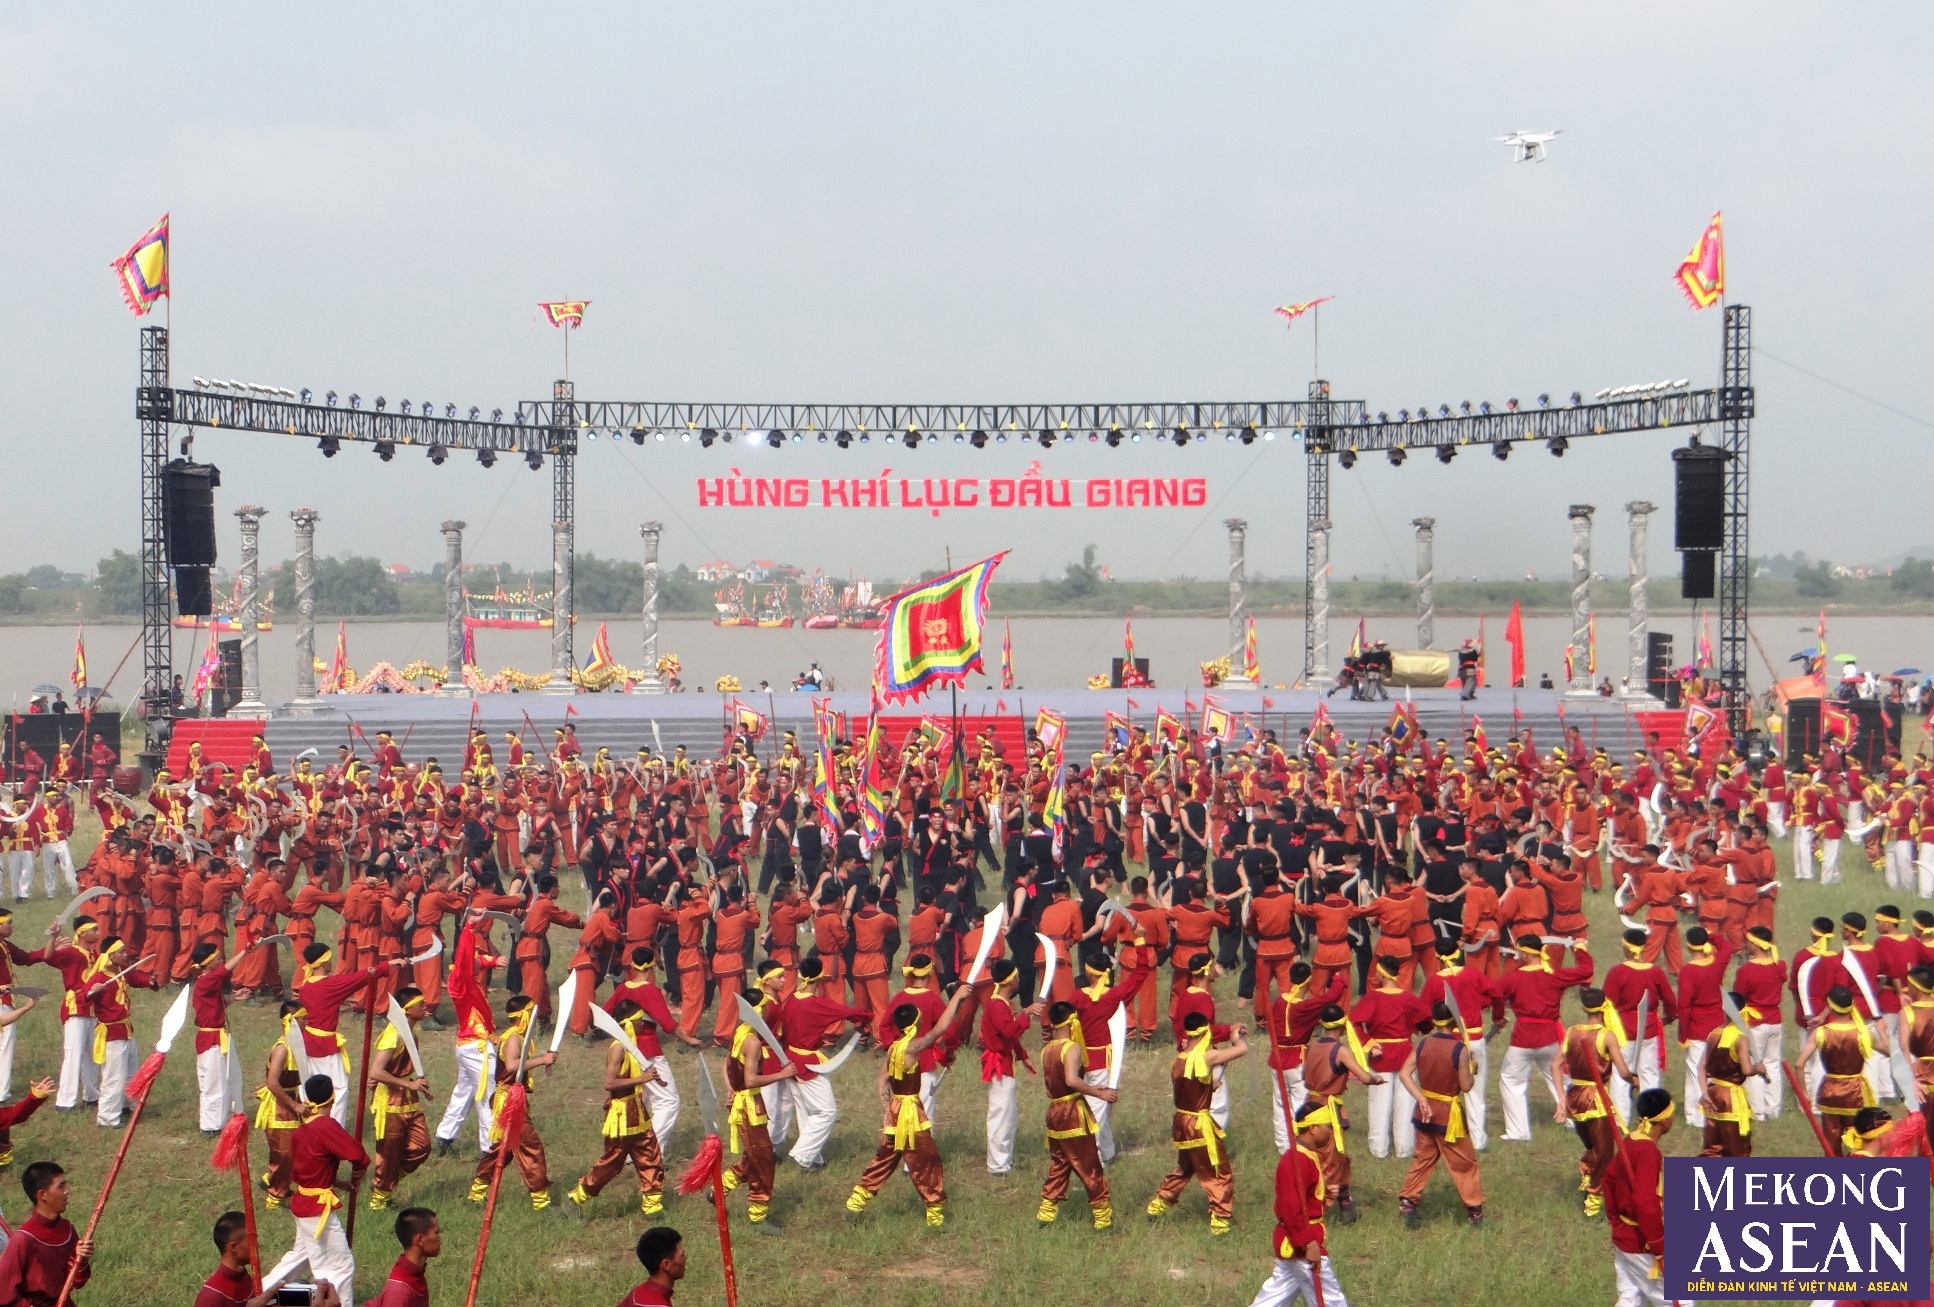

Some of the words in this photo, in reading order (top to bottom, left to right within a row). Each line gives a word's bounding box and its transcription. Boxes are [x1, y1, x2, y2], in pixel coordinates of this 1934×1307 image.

[696, 467, 810, 508] HÙNG
[820, 467, 893, 508] KHÍ
[899, 477, 979, 519] LỤC
[1085, 477, 1207, 508] GIANG
